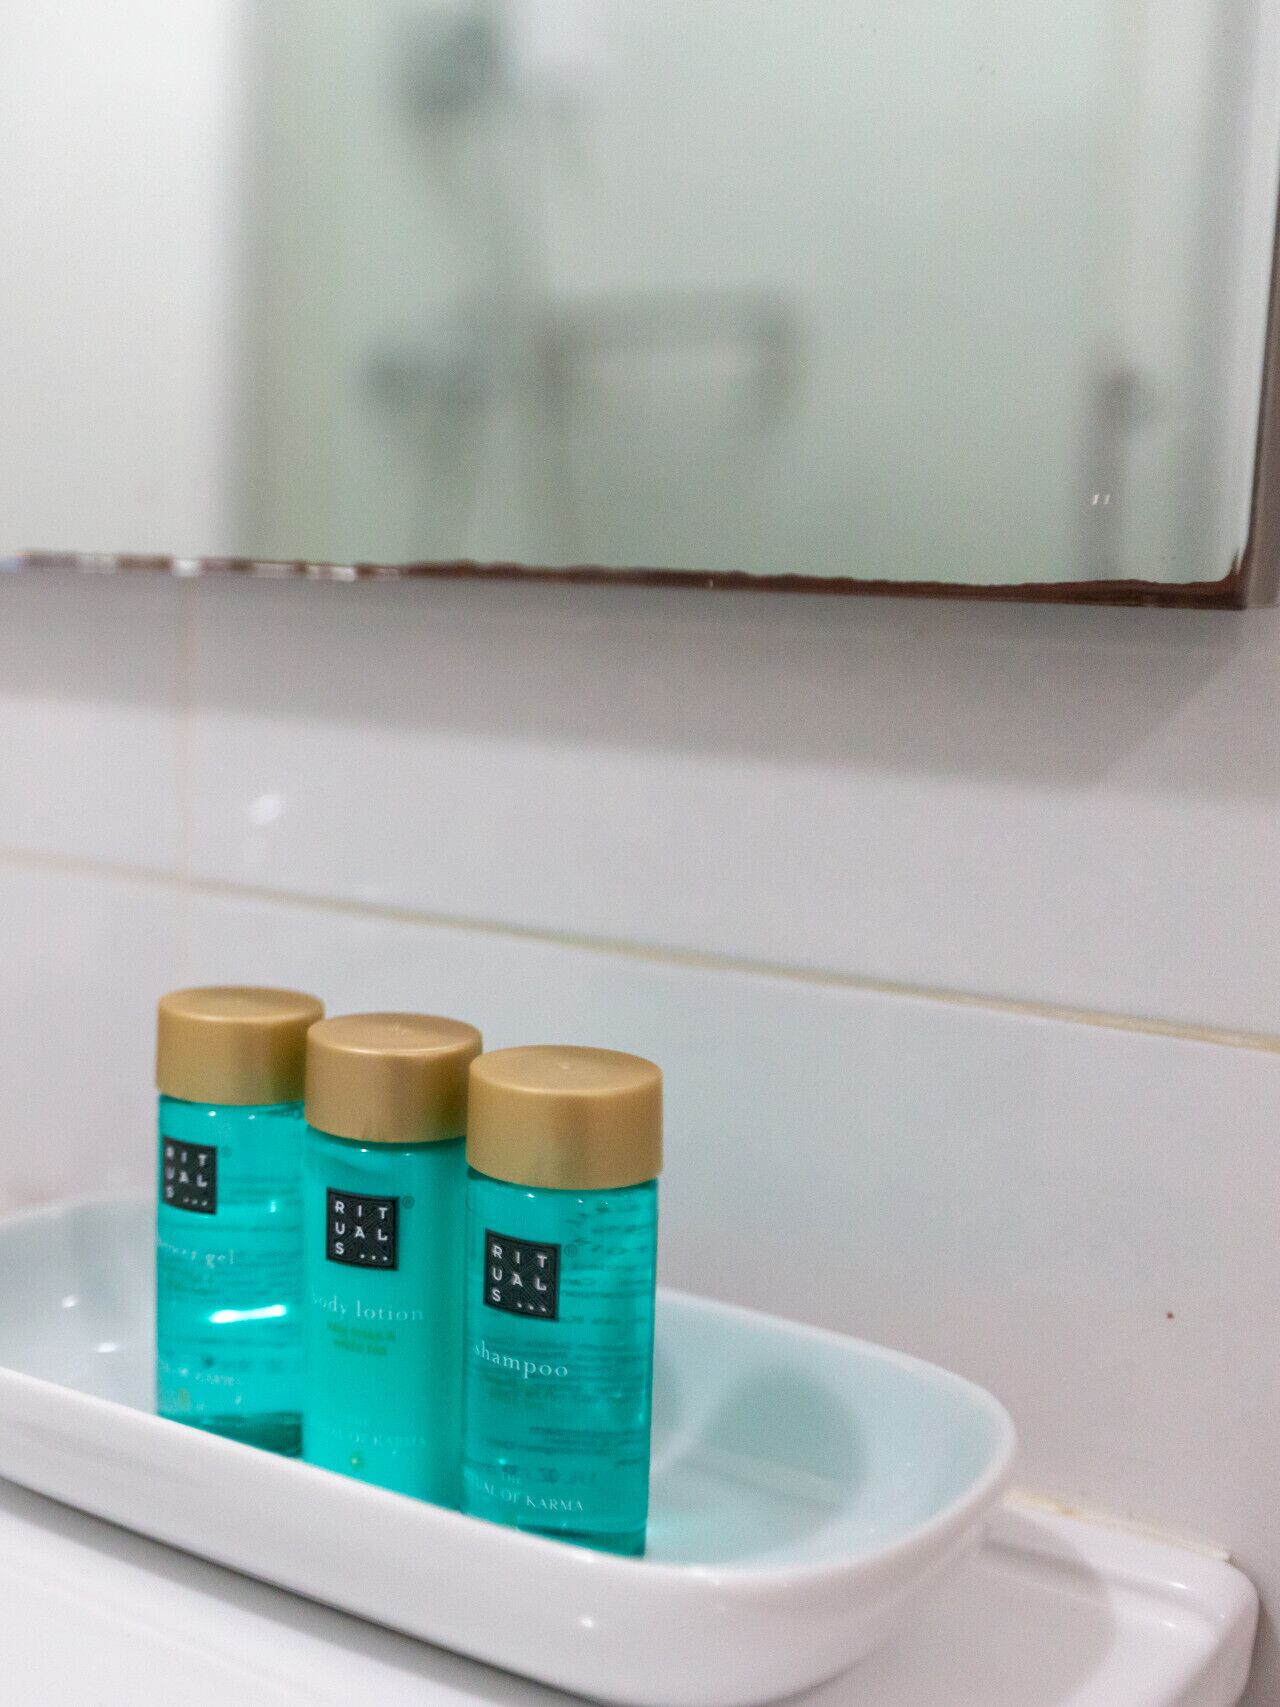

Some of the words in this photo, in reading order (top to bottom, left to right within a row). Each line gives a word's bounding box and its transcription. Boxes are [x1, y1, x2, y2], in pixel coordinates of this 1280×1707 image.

[355, 1299, 424, 1321] lotion
[473, 1339, 569, 1379] shampoo
[500, 1488, 520, 1504] OF
[526, 1495, 584, 1512] KARMA
